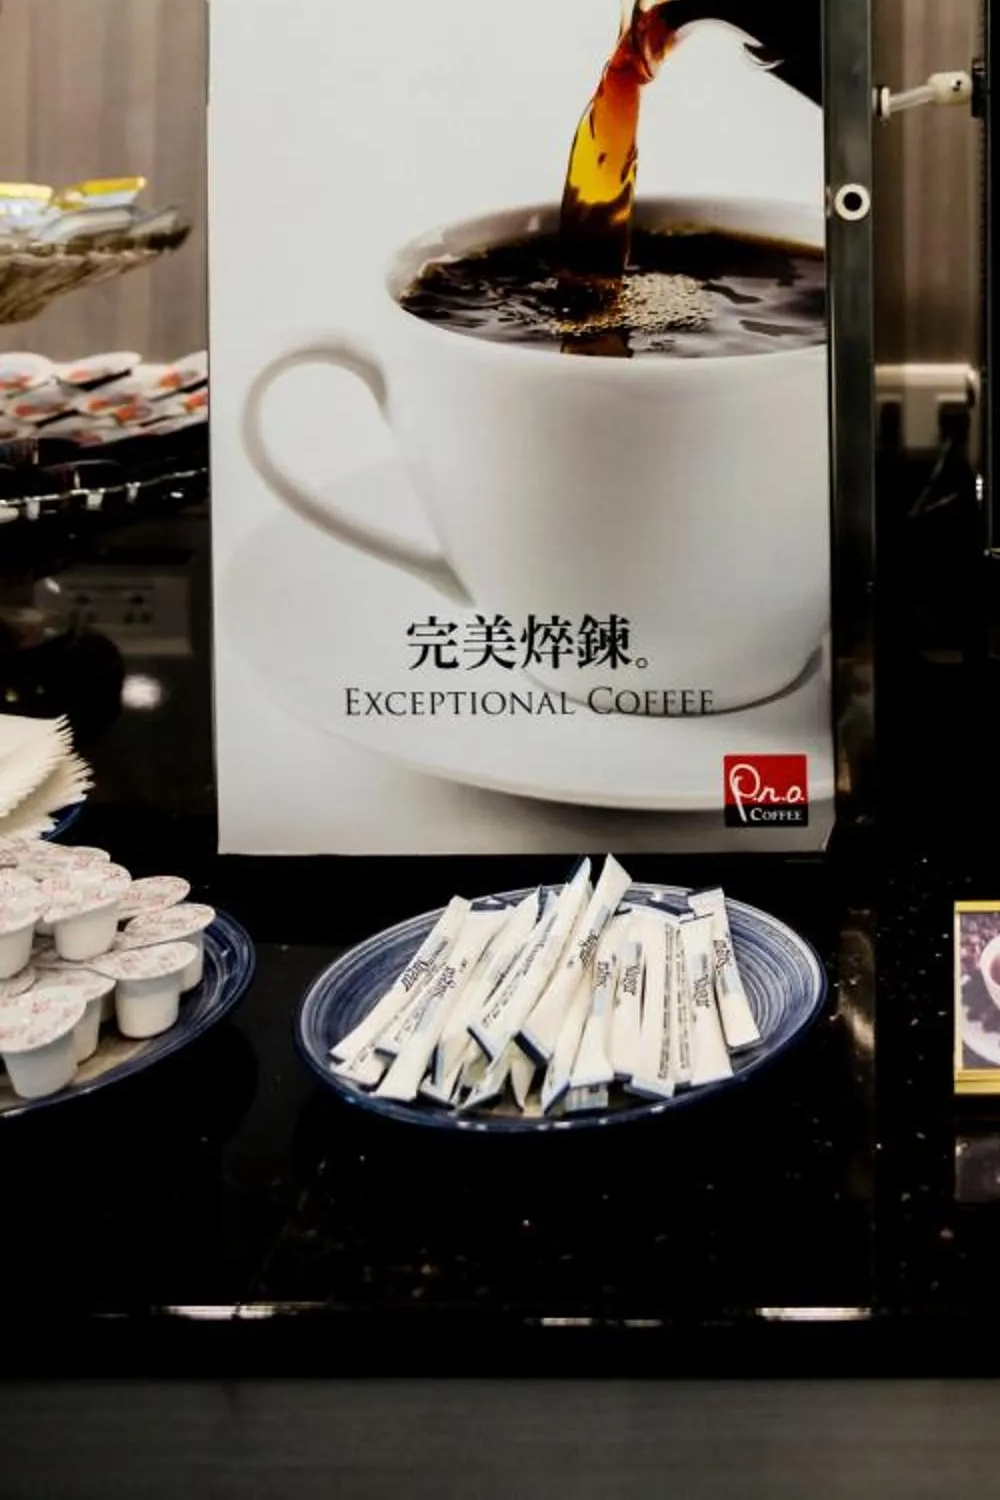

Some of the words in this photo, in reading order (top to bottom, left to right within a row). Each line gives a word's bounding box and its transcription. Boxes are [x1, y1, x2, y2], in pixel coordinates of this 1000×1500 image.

[344, 687, 576, 716] EXCEPTIONAL
[587, 685, 714, 716] COFFEE
[749, 807, 803, 821] COFFEE
